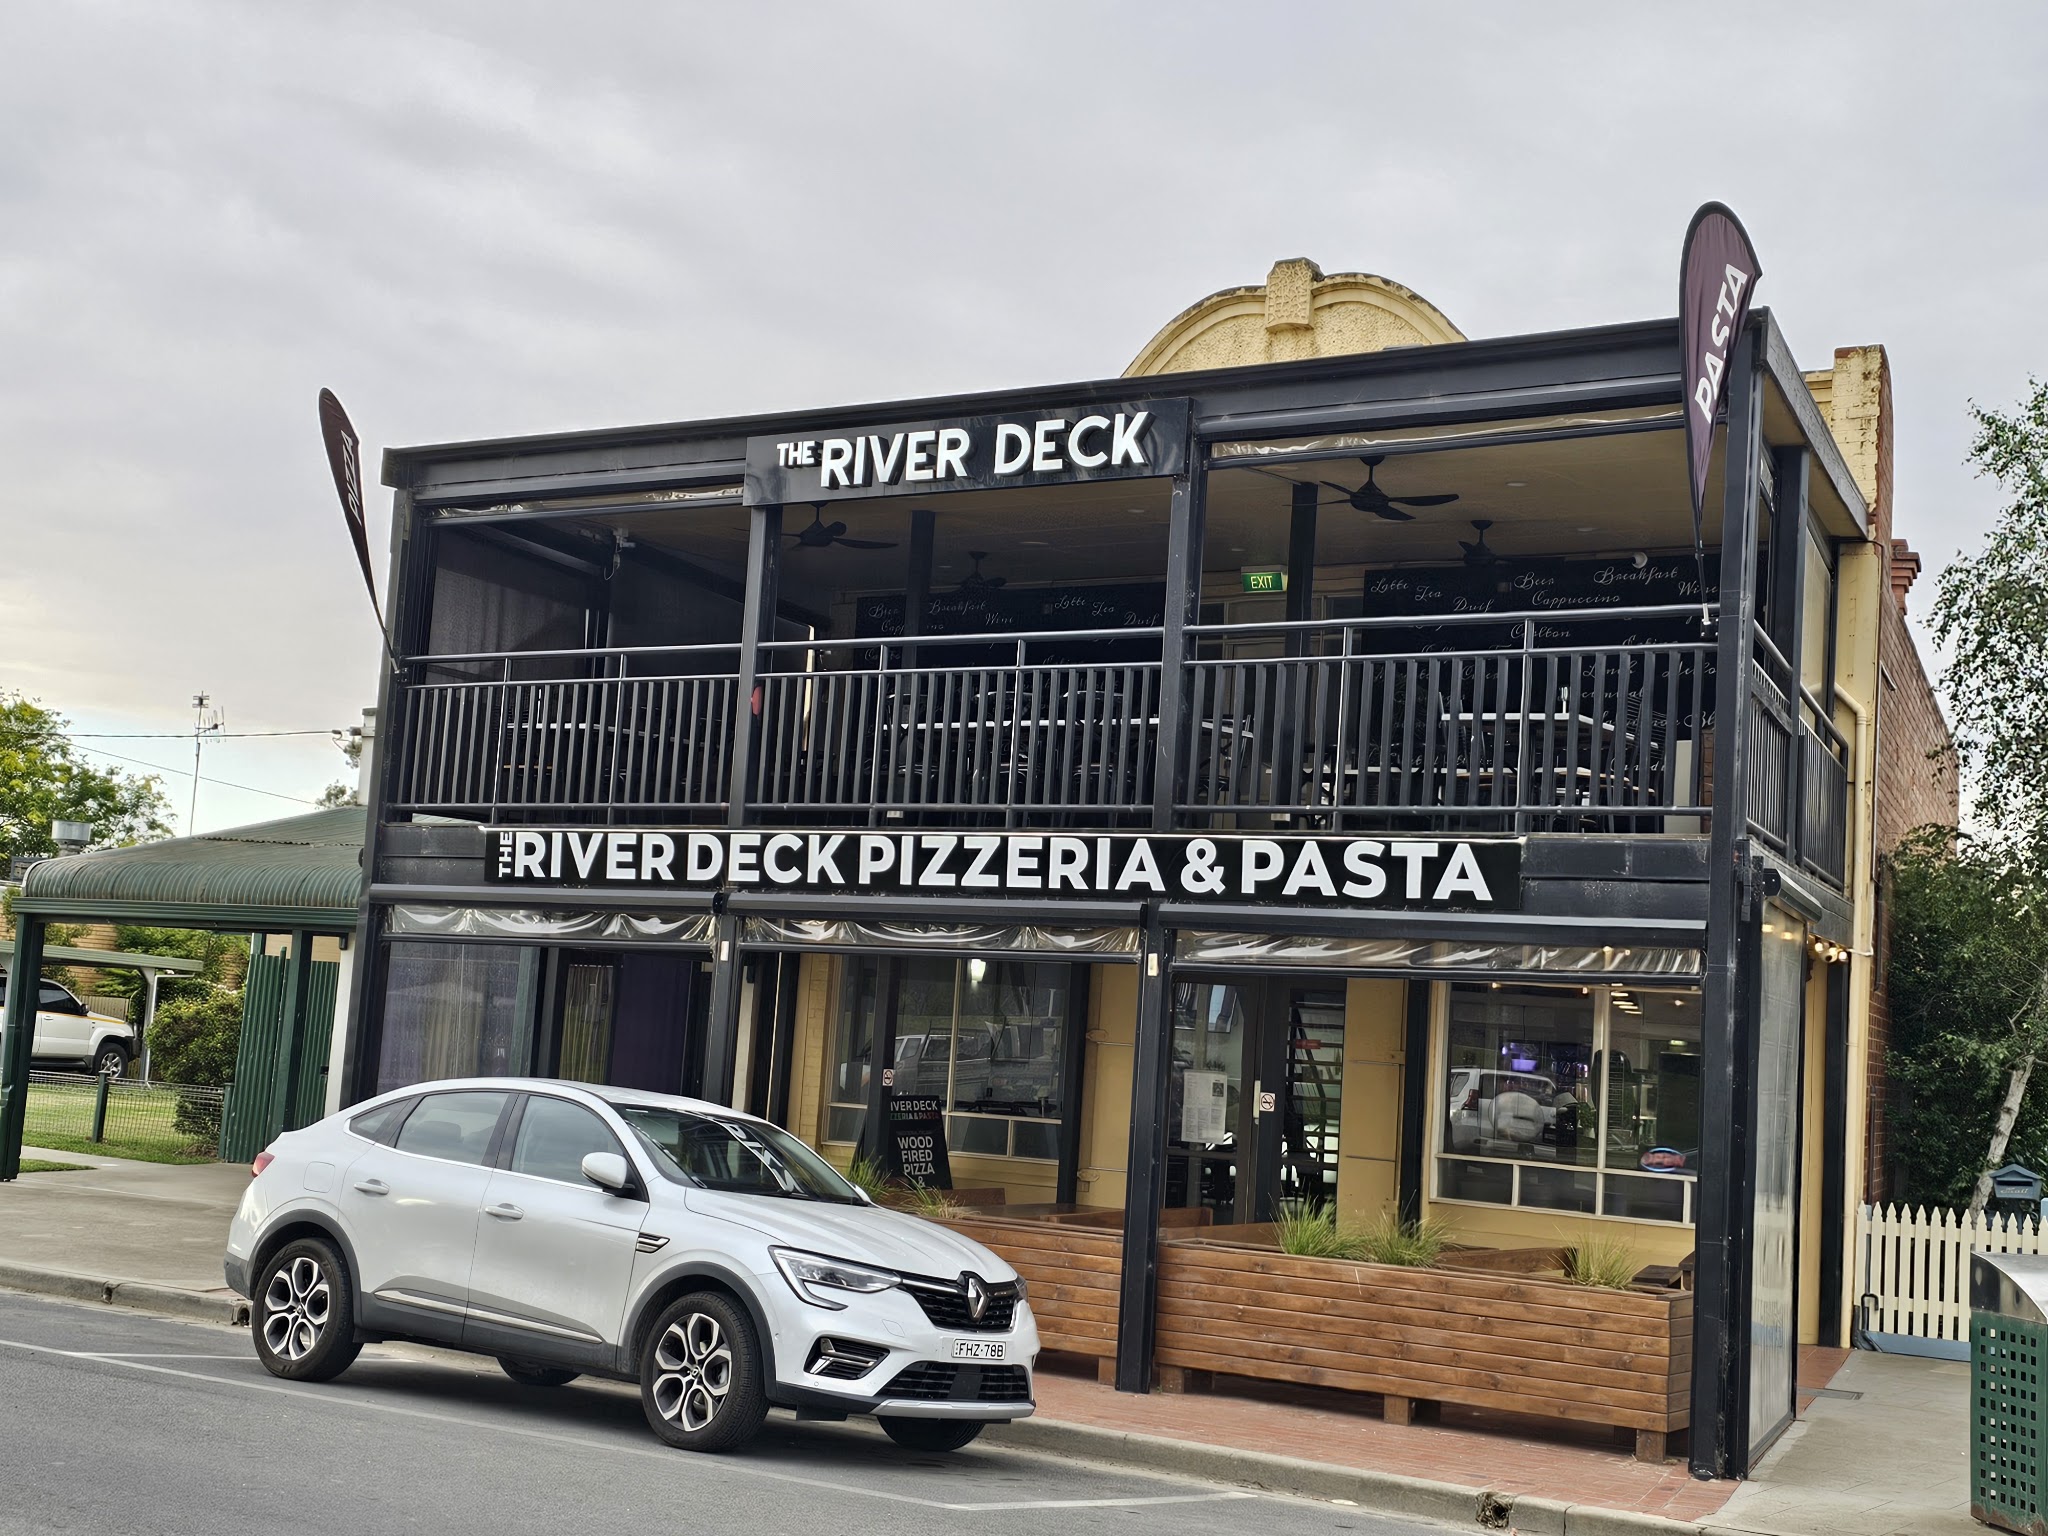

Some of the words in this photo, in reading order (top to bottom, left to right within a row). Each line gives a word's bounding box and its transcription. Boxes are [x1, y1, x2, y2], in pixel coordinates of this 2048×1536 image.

[1695, 263, 1748, 423] PASTA
[777, 441, 815, 467] THE
[821, 428, 970, 488] RIVER
[994, 411, 1149, 475] DECK
[340, 429, 362, 525] PIZZA
[1250, 575, 1273, 589] EXIT
[1514, 571, 1555, 590] Beer
[1593, 566, 1679, 586] Breakfast
[1415, 585, 1443, 602] Tea
[1532, 589, 1620, 608] Cappuccino
[1510, 623, 1571, 639] Clton
[498, 831, 513, 877] THE
[514, 832, 675, 880] RIVER
[686, 834, 845, 885] DECK
[859, 836, 1166, 891] PIZZERIA
[1180, 838, 1225, 895] &
[1241, 840, 1493, 902] PASTA
[890, 1101, 913, 1112] IVER
[913, 1100, 938, 1111] DECK
[897, 1136, 934, 1149] WOOD
[901, 1150, 933, 1163] FIRED
[902, 1163, 935, 1175] PIZZA
[917, 1176, 926, 1188] &
